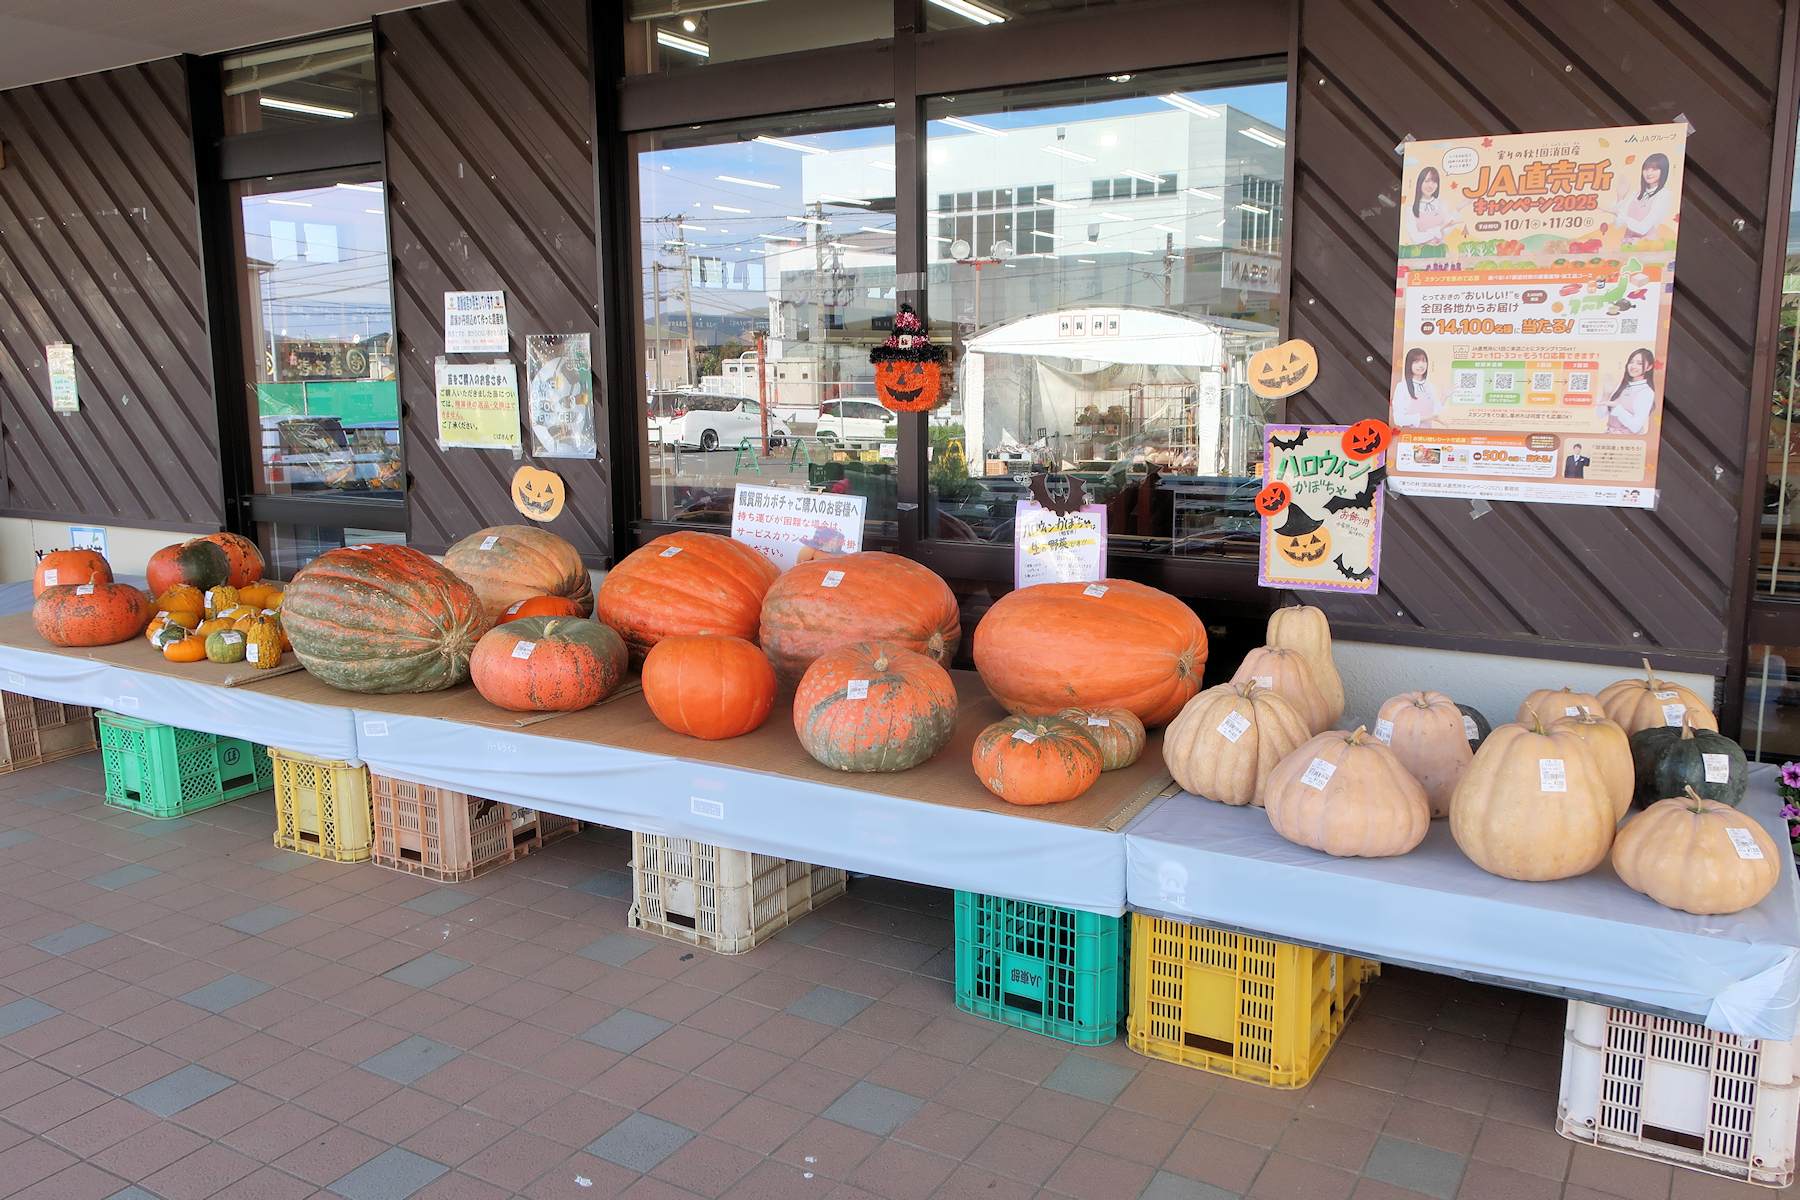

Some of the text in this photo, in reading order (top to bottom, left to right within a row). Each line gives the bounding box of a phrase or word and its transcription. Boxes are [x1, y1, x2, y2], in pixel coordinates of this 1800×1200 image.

[1639, 133, 1677, 143] JAグループ
[1462, 159, 1614, 199] JA直売所
[1474, 194, 1599, 216] キャンペーン2025
[1504, 219, 1530, 231] 10/1
[1549, 217, 1582, 229] 11/30
[1420, 302, 1519, 314] 全国各地からお届け
[447, 374, 508, 386] 苗をご購入のお客さまへ
[440, 389, 516, 398] ご購入いただきました苗につい
[440, 400, 516, 410] ては、精算後の返品・交換はで
[441, 411, 464, 420] きません。
[442, 421, 478, 430] ご了承ください。
[1276, 450, 1371, 480] ハロウィン
[1292, 480, 1347, 495] かぼちゃ
[739, 490, 859, 518] 観賞用カボチャご購入のお客様へ
[738, 511, 842, 532] 持ち運びが困難な場合は、
[1340, 510, 1370, 527] お飾り用
[1011, 969, 1042, 988] JA東部
